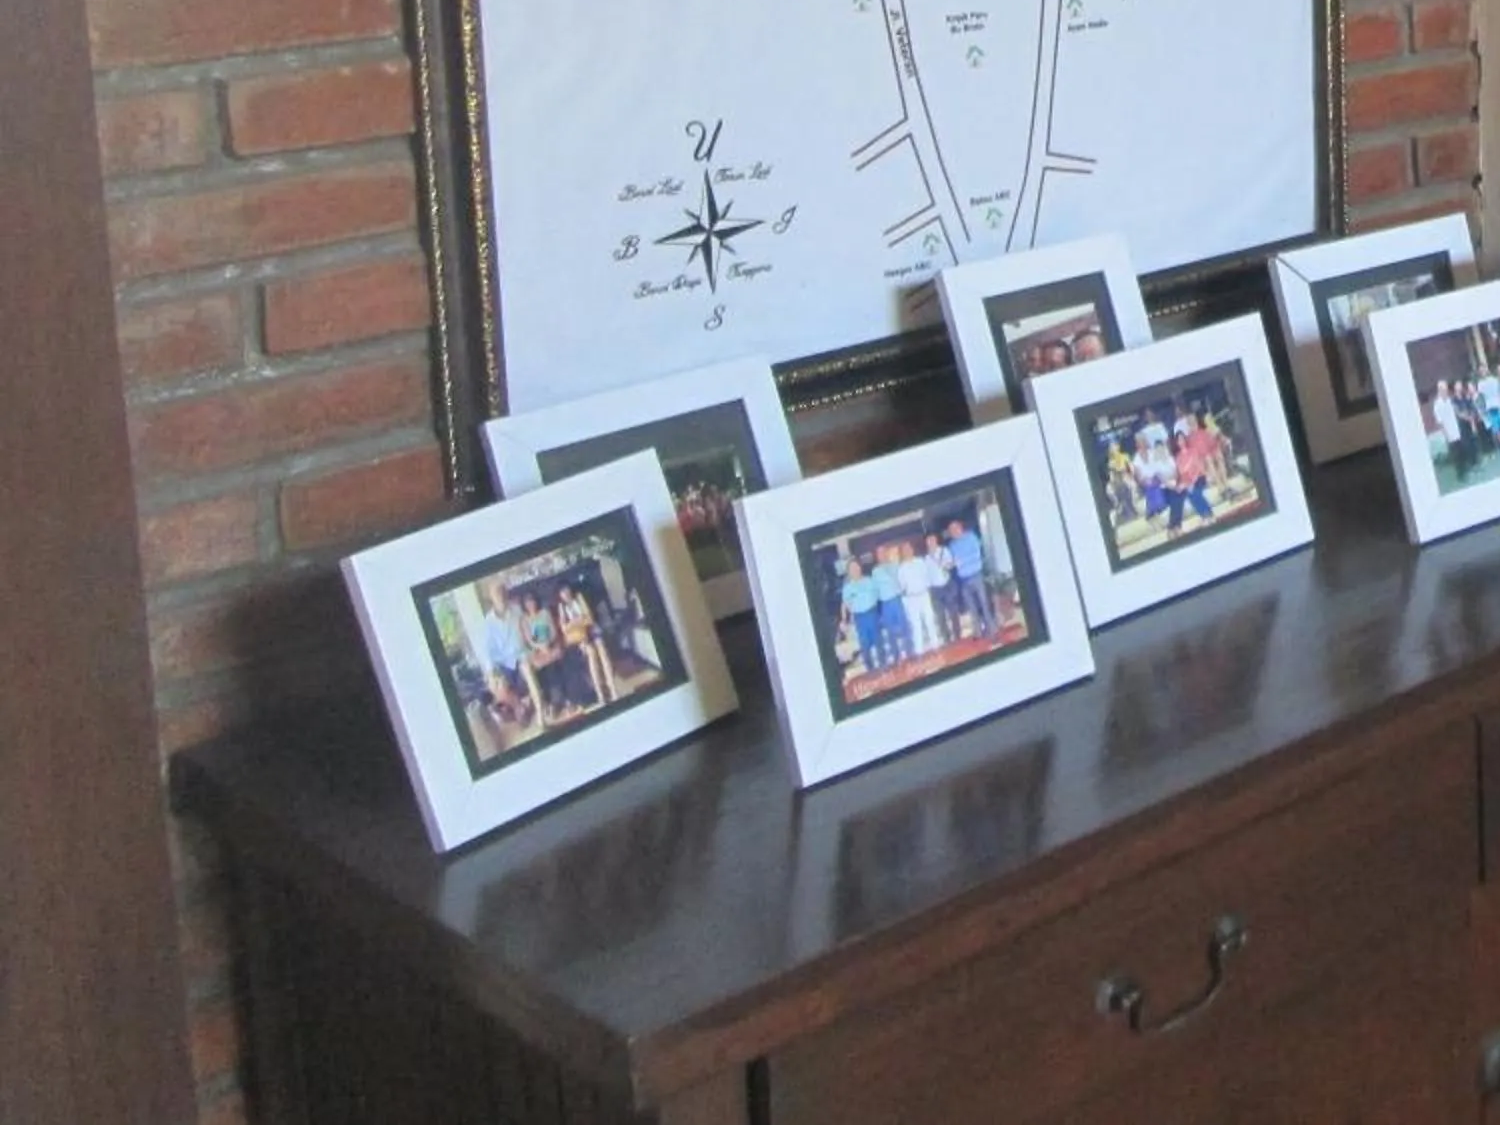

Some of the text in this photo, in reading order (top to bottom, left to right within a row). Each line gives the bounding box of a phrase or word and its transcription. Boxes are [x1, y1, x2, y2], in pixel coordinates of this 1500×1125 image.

[685, 118, 724, 163] U
[612, 234, 641, 262] B
[704, 303, 727, 332] S
